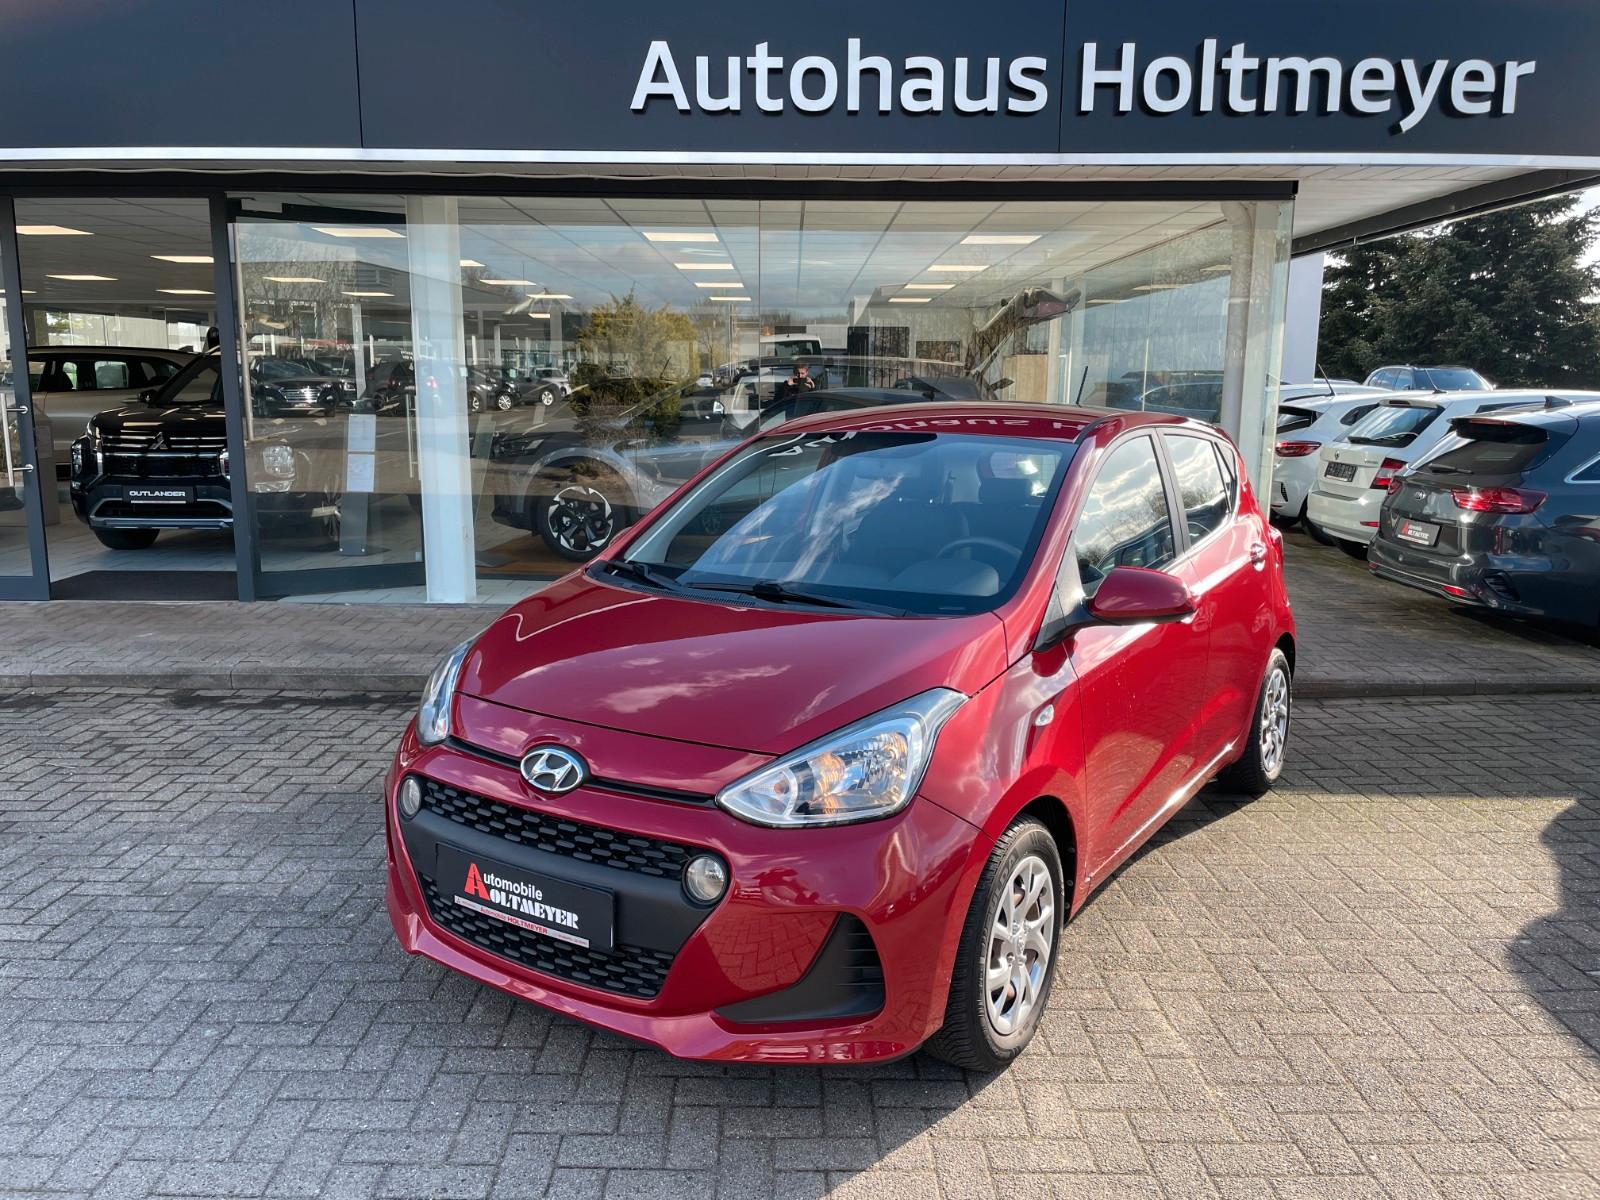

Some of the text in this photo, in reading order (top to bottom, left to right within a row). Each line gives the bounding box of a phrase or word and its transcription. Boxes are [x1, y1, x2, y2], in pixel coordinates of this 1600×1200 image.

[629, 37, 1536, 134] Autohaus Holtmeyer
[464, 862, 543, 901] Automobile
